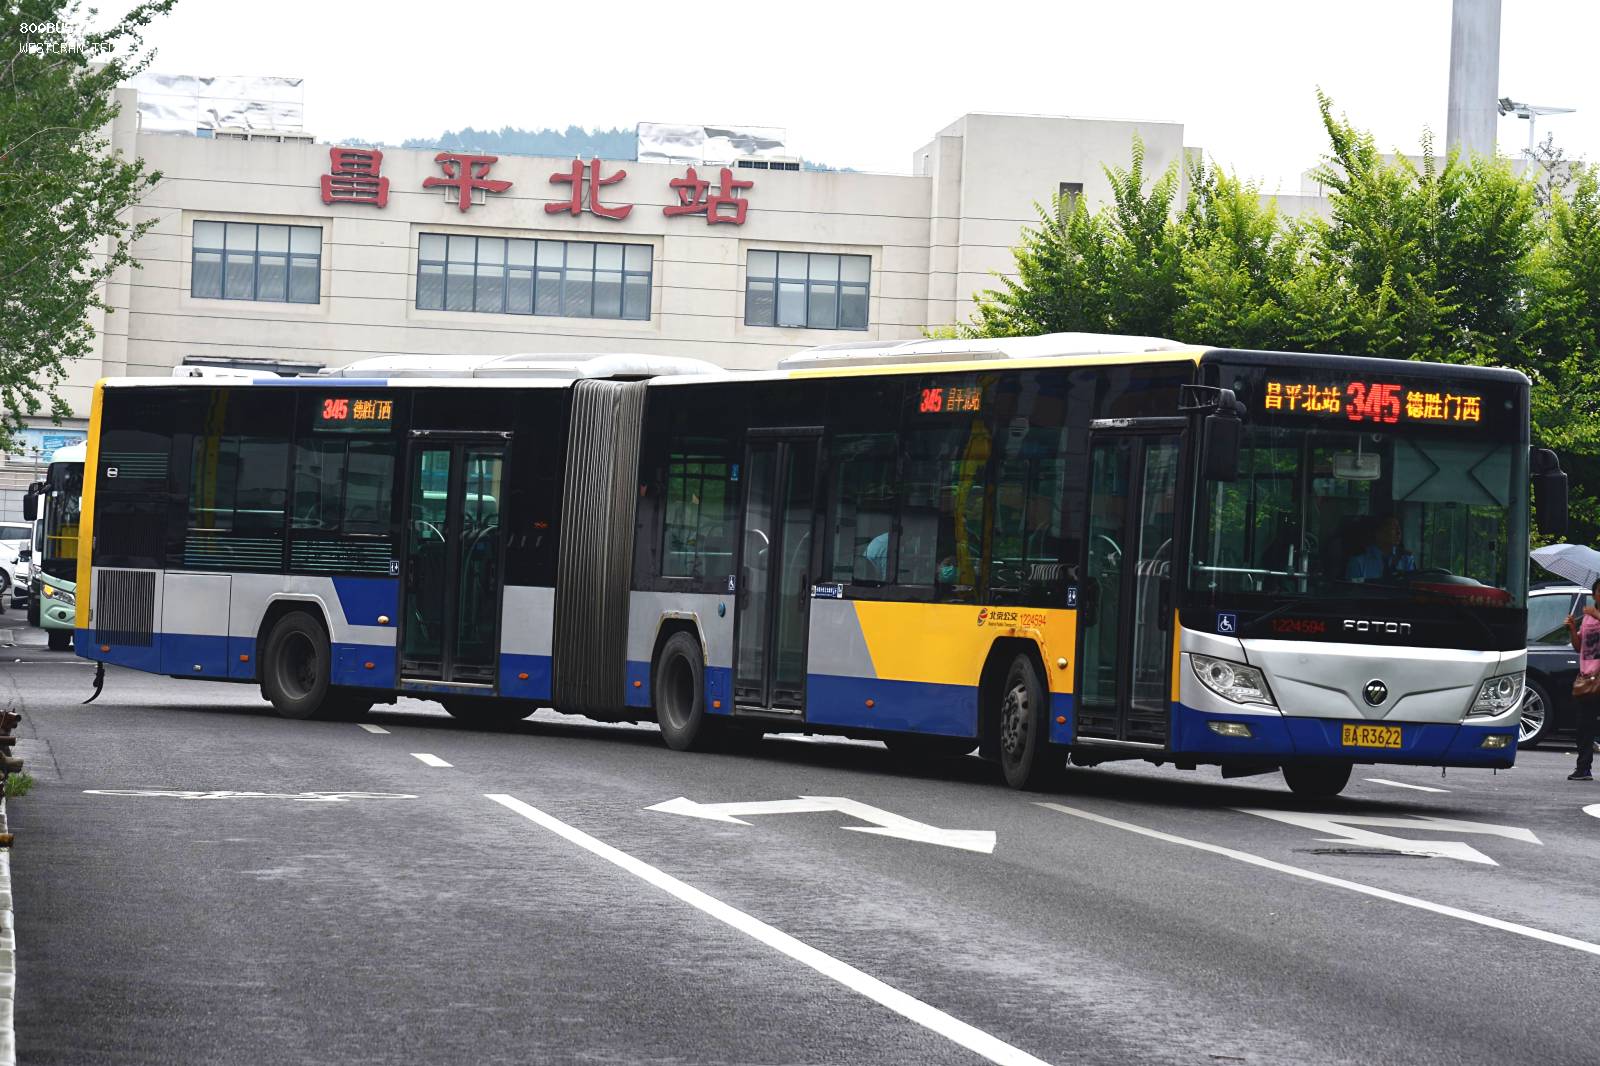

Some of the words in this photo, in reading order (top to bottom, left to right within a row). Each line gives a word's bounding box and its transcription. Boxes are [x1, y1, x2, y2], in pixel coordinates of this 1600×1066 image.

[320, 147, 753, 225] 昌平北站
[323, 399, 348, 420] 345
[920, 388, 944, 412] 345
[1265, 382, 1341, 413] 昌平北站
[1346, 382, 1402, 423] 345
[1406, 391, 1482, 421] 德胜门西
[990, 611, 1017, 621] 北京公交
[1343, 619, 1412, 634] FOTON
